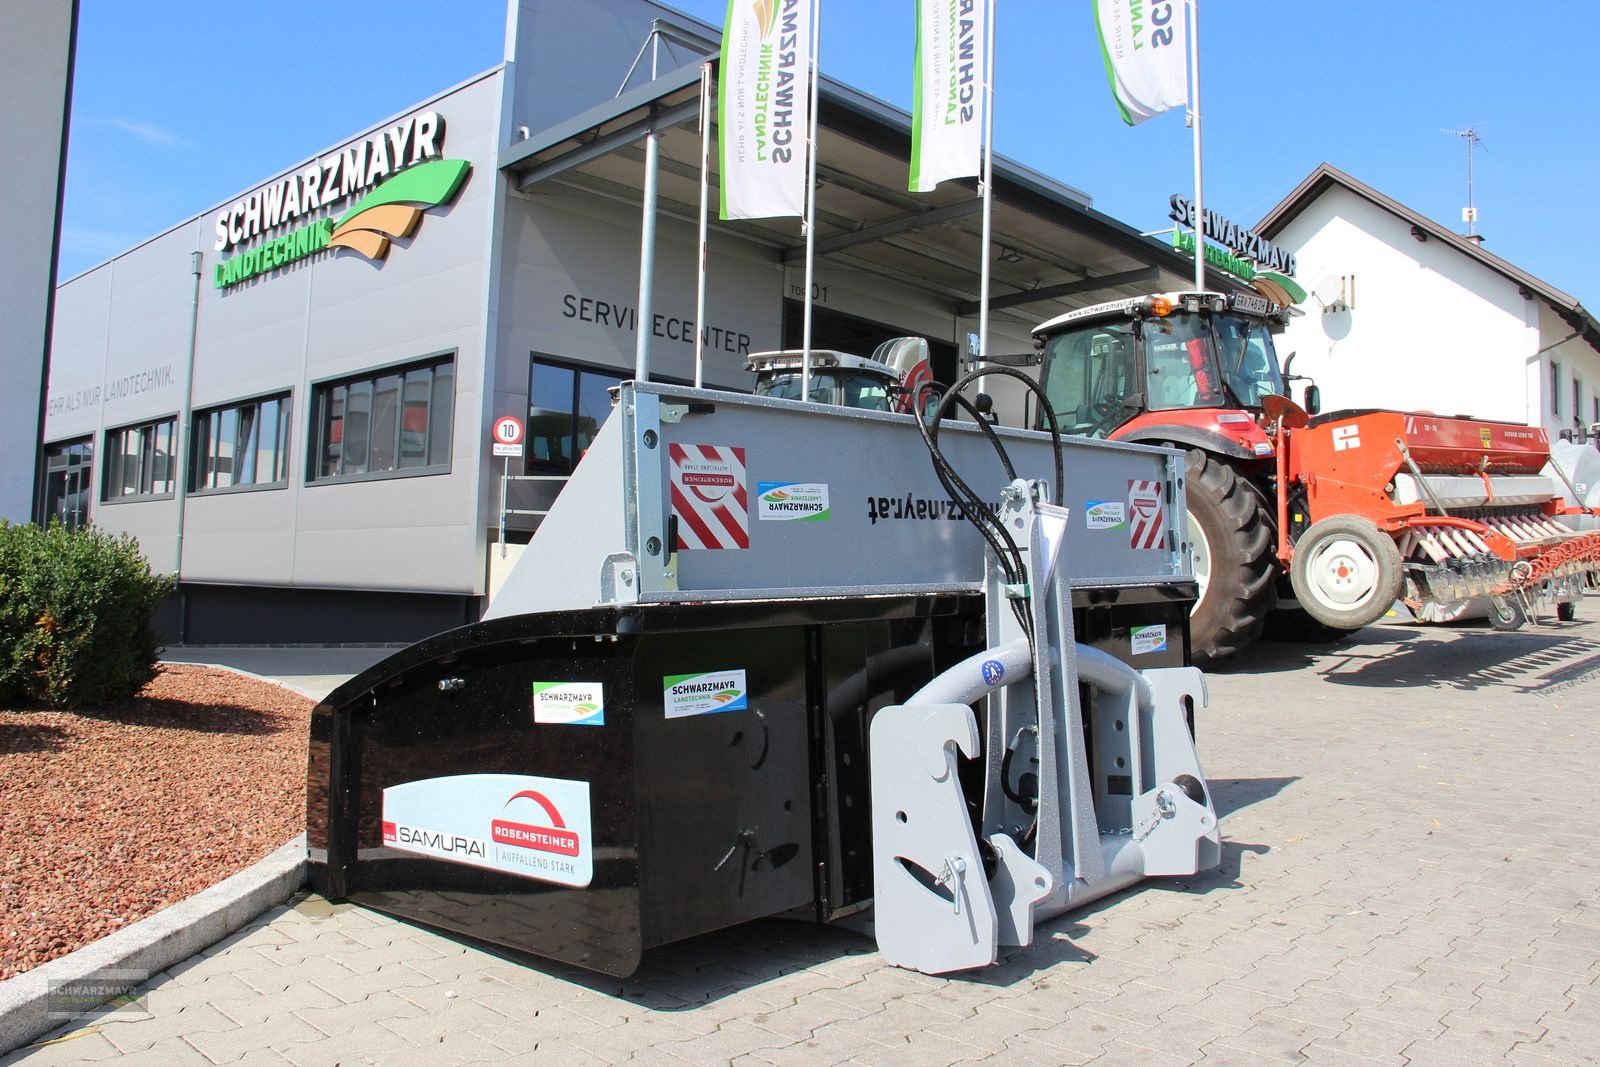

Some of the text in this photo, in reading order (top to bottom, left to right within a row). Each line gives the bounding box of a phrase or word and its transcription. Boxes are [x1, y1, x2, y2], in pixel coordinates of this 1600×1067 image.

[214, 111, 446, 252] SCHWARZMAYR
[213, 217, 335, 289] LANDTECHNIK
[563, 294, 752, 355] SERVIECENTER
[83, 386, 101, 408] NUR
[503, 424, 514, 437] 10
[684, 476, 733, 484] ROSENSTEINER
[768, 502, 823, 511] SCHWARZMAYR
[539, 692, 593, 702] SCHWARZMAYR
[672, 681, 735, 695] SCHWARZMAYR
[399, 826, 486, 858] SAMURAI
[495, 826, 575, 849] ROSENSTEINER
[501, 851, 575, 874] AUFFALLEND STARK
